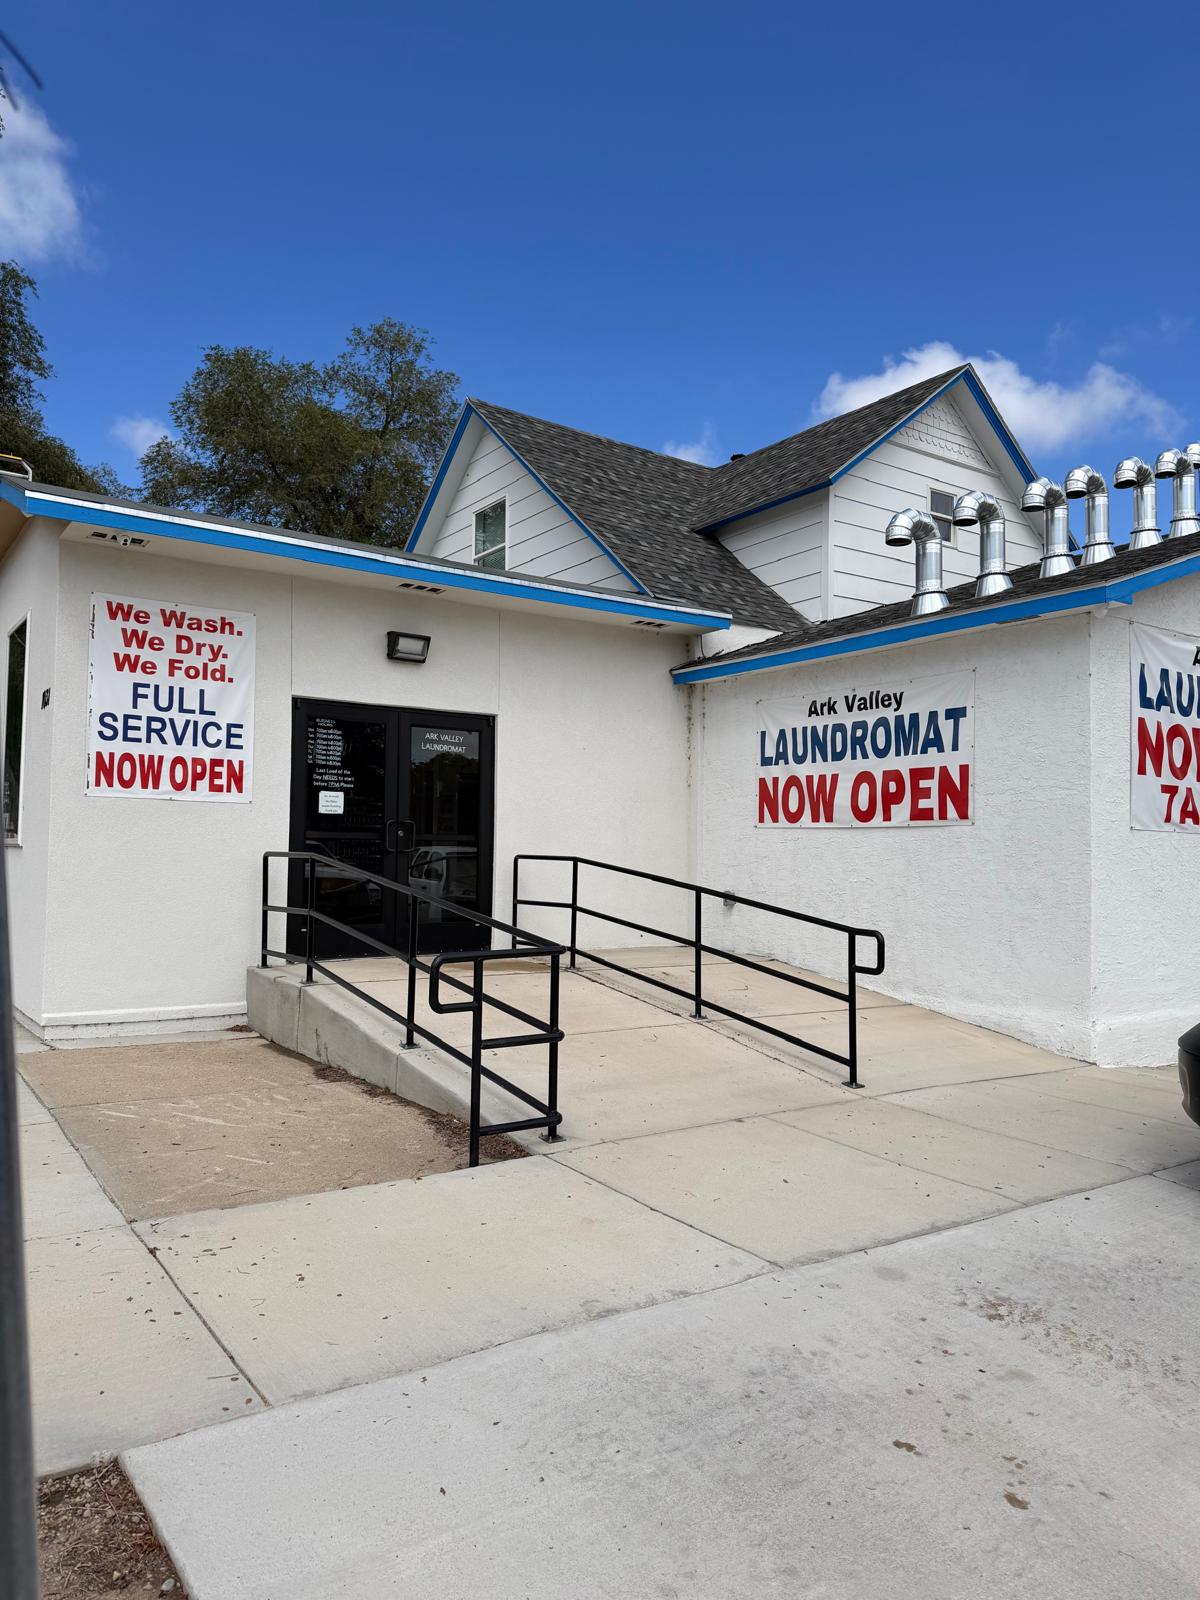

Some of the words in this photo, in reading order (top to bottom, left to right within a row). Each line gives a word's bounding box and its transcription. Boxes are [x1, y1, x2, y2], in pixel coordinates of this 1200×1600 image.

[106, 600, 151, 625] We
[160, 608, 243, 637] Wash.
[121, 627, 165, 651] We
[175, 634, 228, 662] Dry.
[113, 652, 158, 675] We
[168, 658, 234, 683] Fold.
[132, 682, 216, 716] FULL
[808, 697, 838, 717] Ark
[844, 690, 904, 713] Valley
[1139, 662, 1200, 719] LAU
[97, 711, 244, 750] SERVICE
[421, 742, 467, 753] LAUNDROMAT
[425, 732, 439, 741] ARK
[440, 734, 463, 742] VALLEY
[760, 706, 967, 767] LAUNDROMAT
[94, 751, 164, 790] NOW
[169, 755, 244, 794] OPEN
[758, 773, 840, 824] NOW
[850, 764, 970, 823] OPEN
